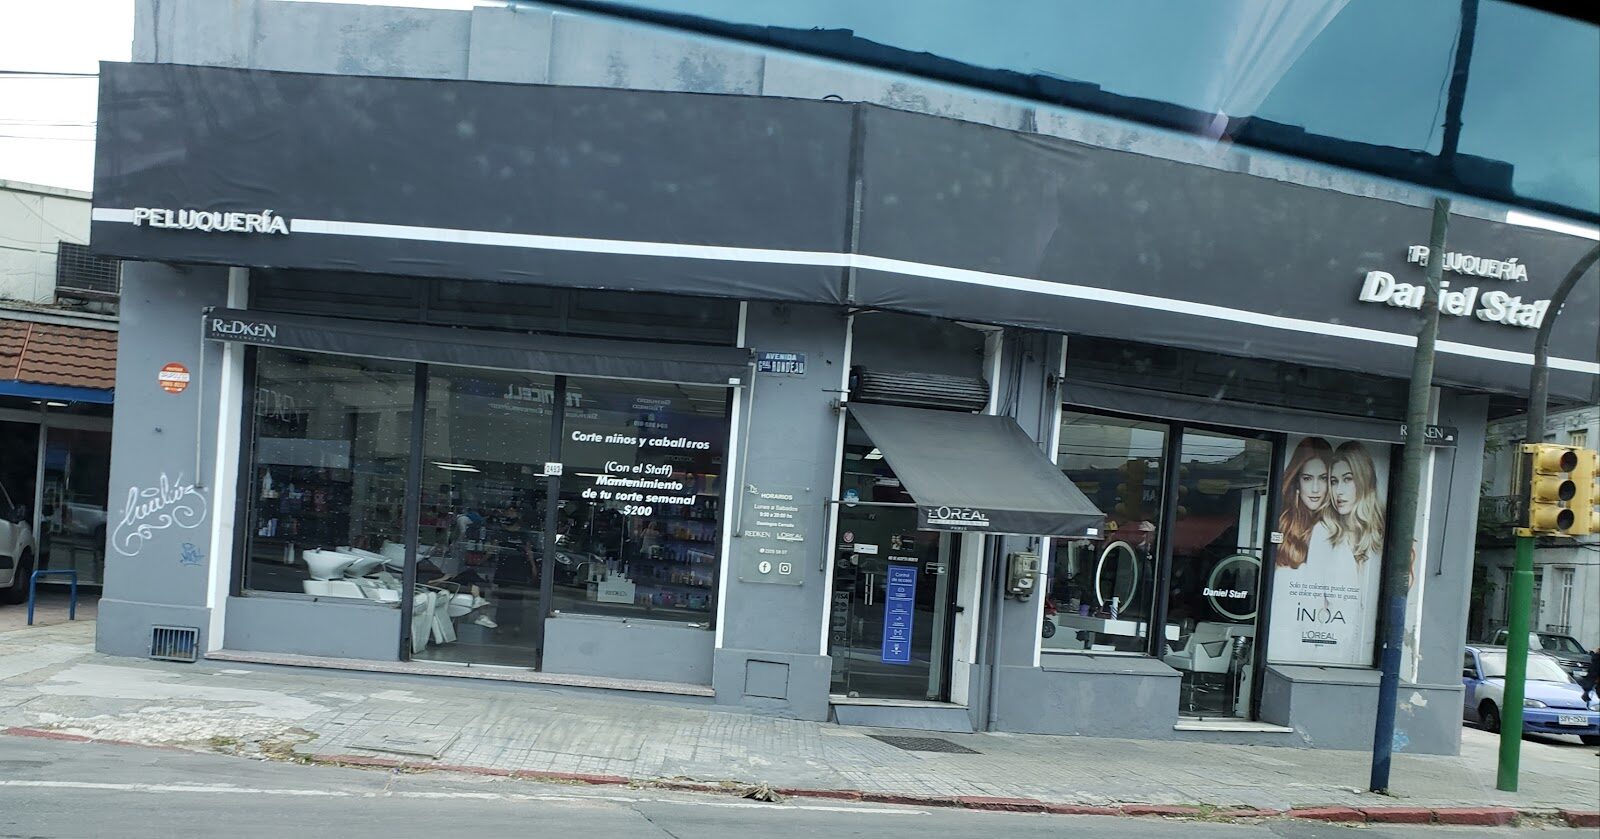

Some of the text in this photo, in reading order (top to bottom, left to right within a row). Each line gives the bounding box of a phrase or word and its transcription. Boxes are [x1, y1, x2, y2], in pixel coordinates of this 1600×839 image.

[133, 207, 289, 235] PELUQUERÍA
[1407, 245, 1528, 282] PUQUERÍA
[212, 318, 277, 338] REDKEN
[765, 353, 797, 361] AVENIDA
[571, 431, 710, 450] Corte niños y caballeros
[604, 461, 673, 477] (Con el Staff)
[595, 475, 683, 490] Mantenimiento
[582, 488, 696, 505] de tu corte semanal
[623, 505, 652, 516] $200
[1202, 587, 1247, 600] Daniel Staff
